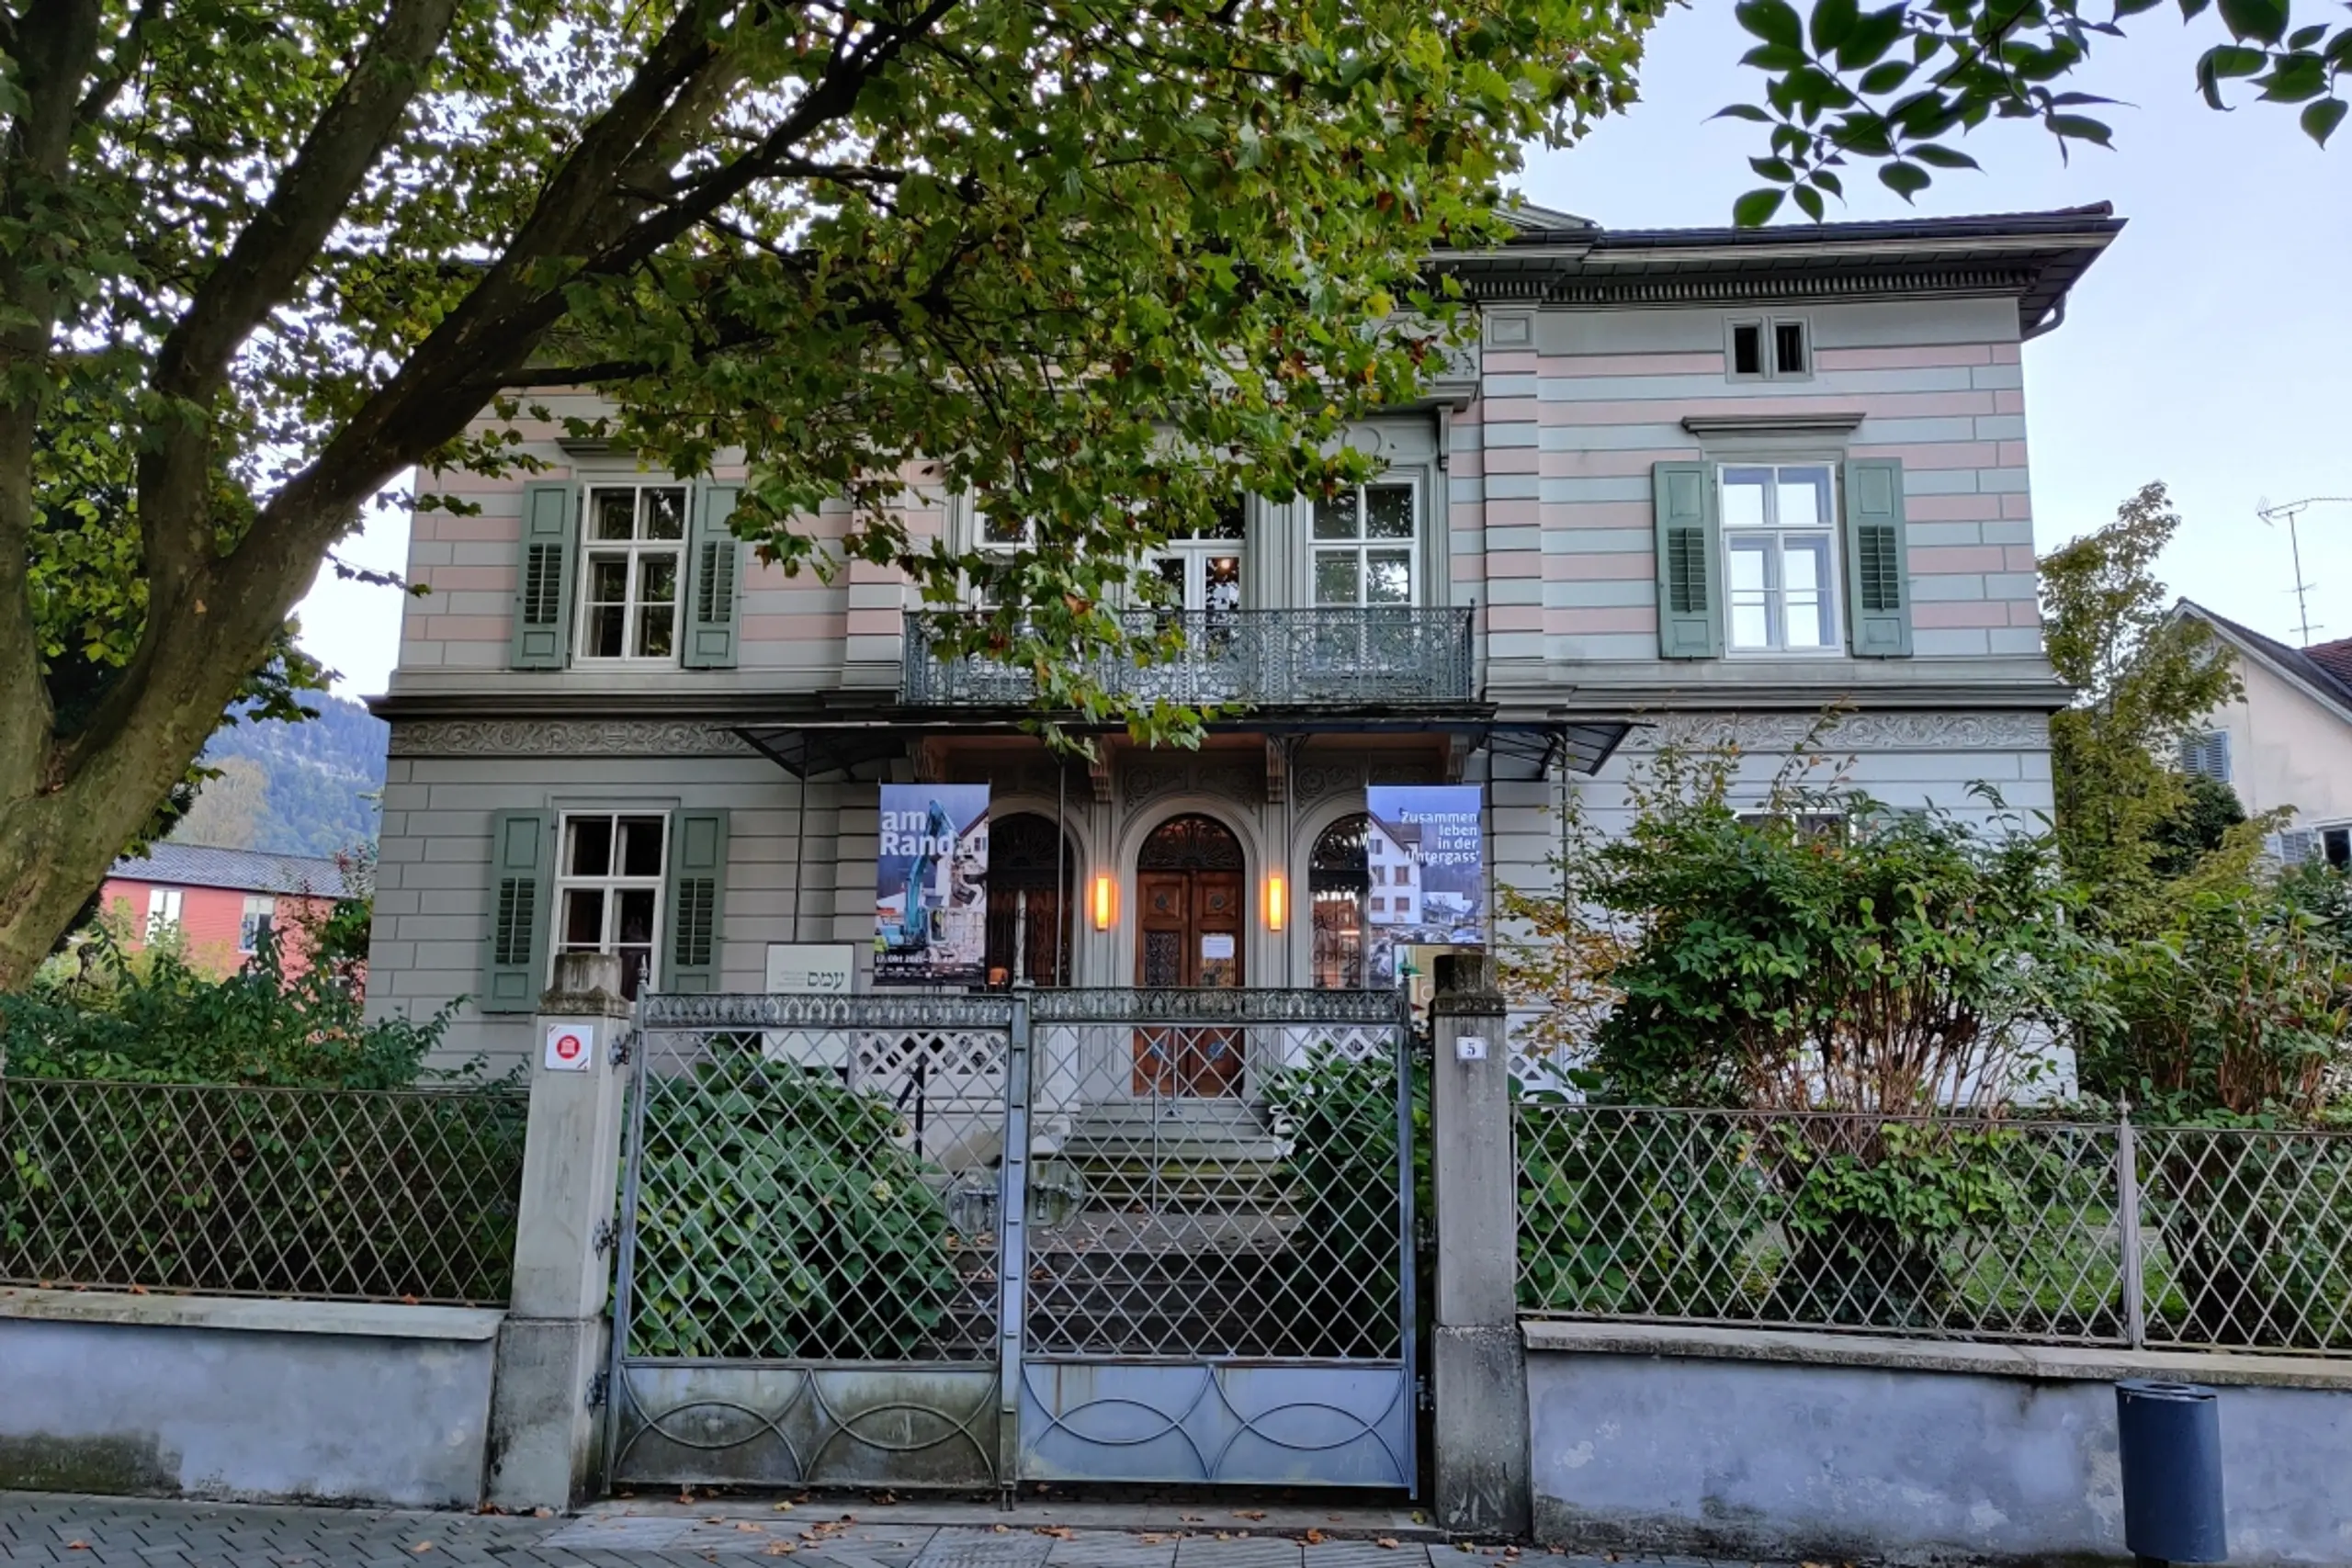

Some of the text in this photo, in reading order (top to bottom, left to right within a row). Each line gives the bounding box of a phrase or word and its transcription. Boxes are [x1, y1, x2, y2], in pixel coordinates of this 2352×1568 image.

[882, 811, 927, 831] am
[1401, 811, 1477, 824] Zusammen
[1439, 824, 1477, 836] leben
[880, 829, 955, 856] Rand
[1438, 837, 1478, 850] in der
[1466, 1043, 1476, 1055] 5
